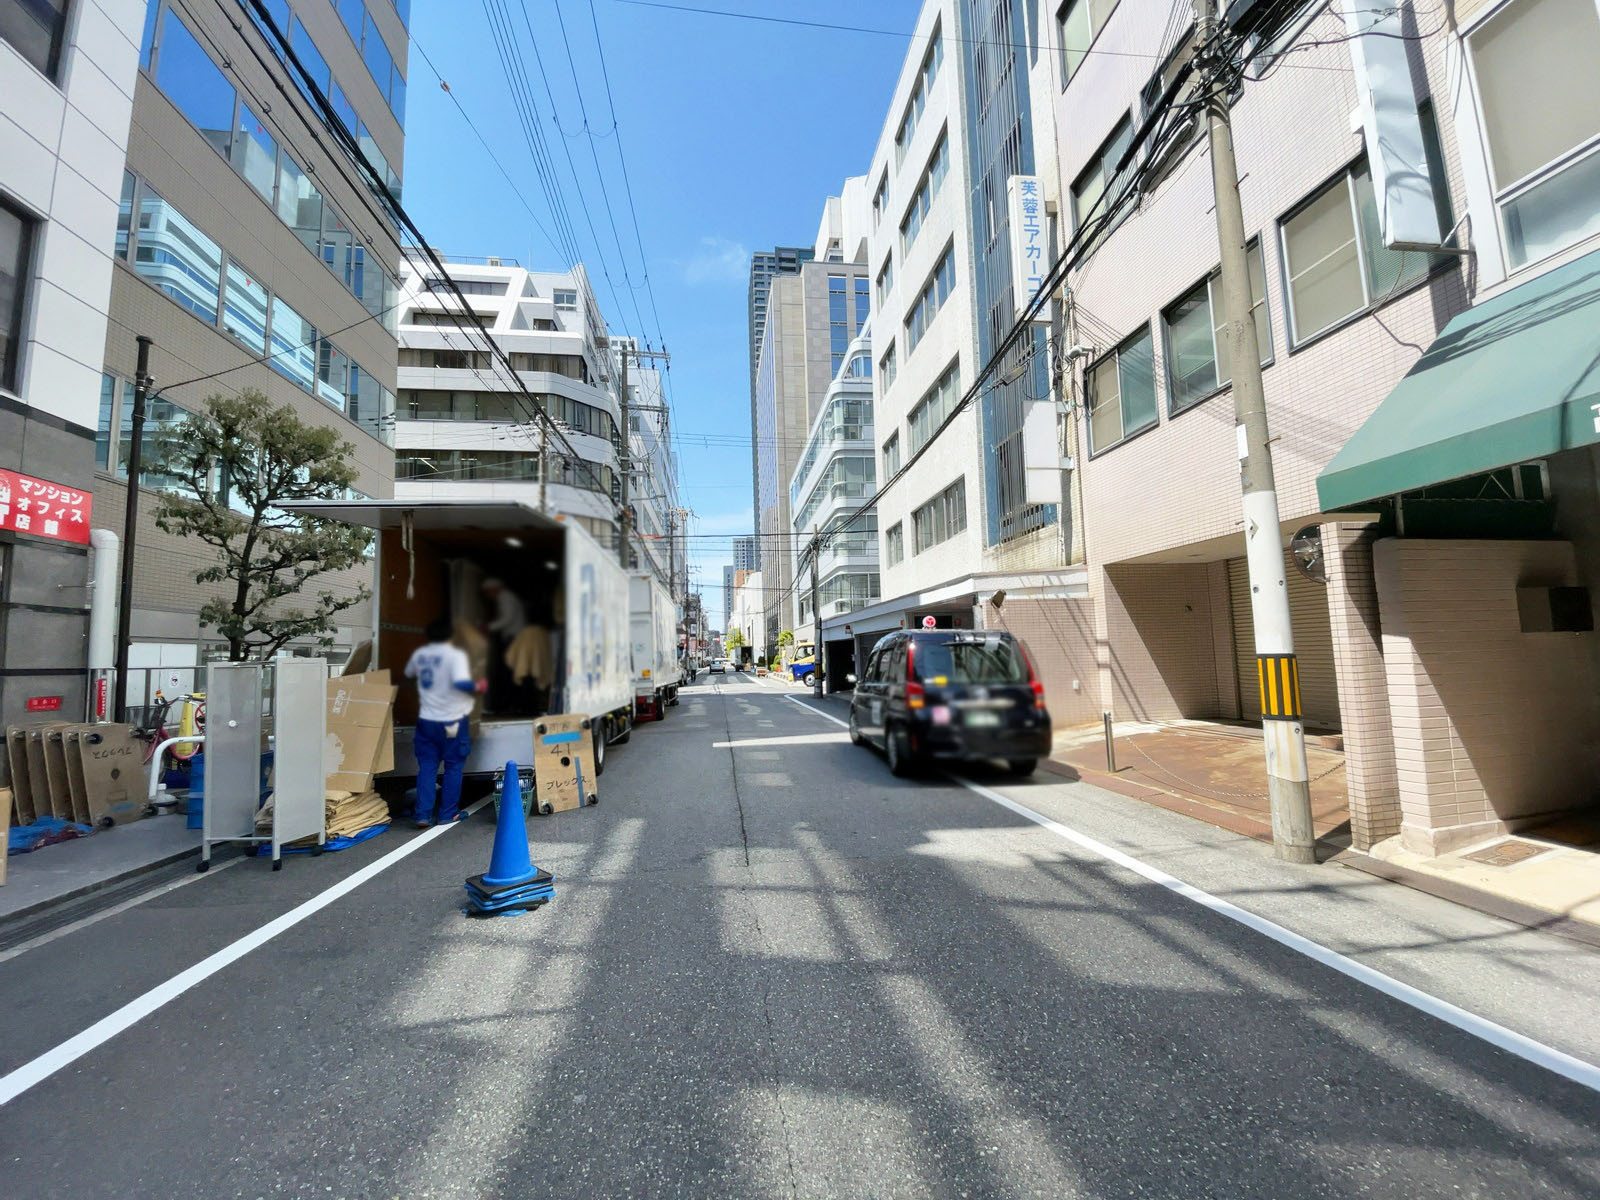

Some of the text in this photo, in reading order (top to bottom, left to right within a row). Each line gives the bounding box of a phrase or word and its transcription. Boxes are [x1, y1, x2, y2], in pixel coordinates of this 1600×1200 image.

[1020, 180, 1046, 317] 芙蓉エアカーゴ
[19, 478, 83, 505] マンション
[17, 497, 83, 523] オフィス
[551, 742, 571, 757] 41
